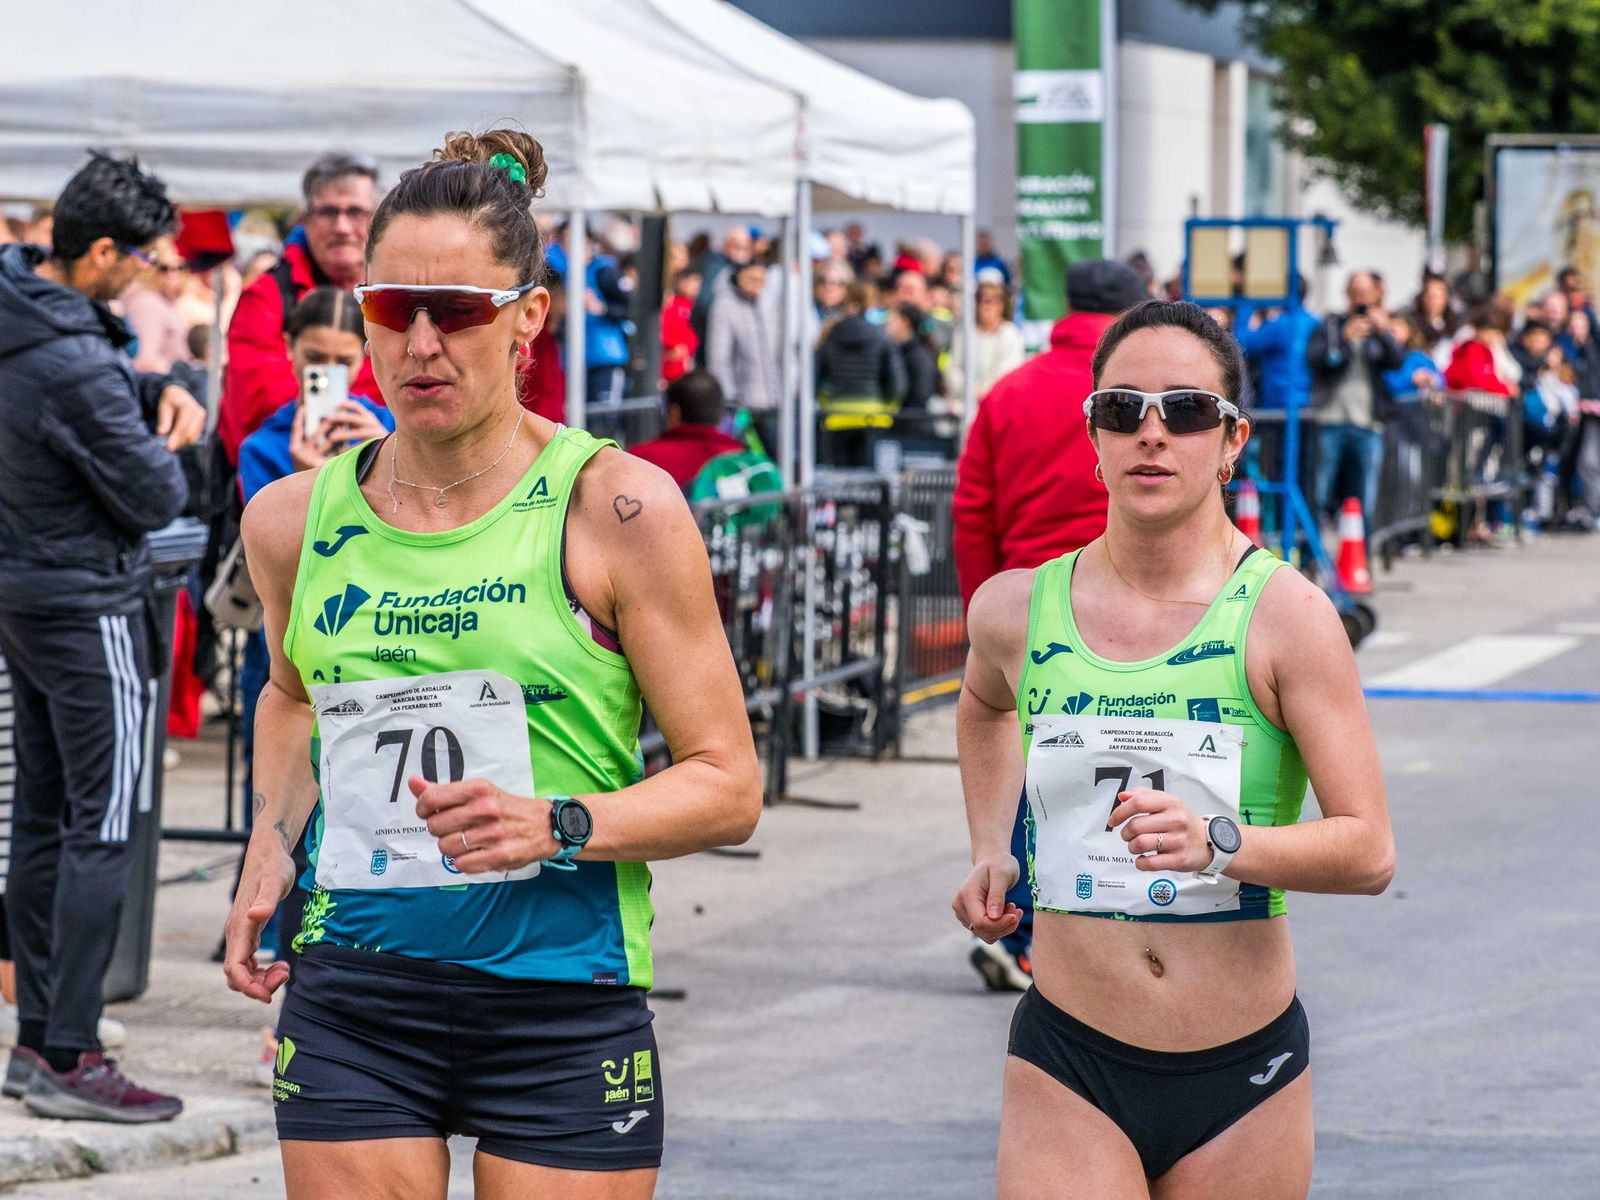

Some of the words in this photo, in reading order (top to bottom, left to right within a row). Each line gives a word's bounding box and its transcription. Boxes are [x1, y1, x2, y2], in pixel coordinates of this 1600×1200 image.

[376, 576, 526, 609] Fundación
[373, 606, 478, 640] Unicaja
[371, 644, 417, 663] Jaén
[392, 695, 415, 704] MARCHA
[1098, 691, 1177, 707] Fundación
[374, 726, 465, 803] 70
[374, 828, 401, 836] AINHOA
[1087, 855, 1110, 863] MARIA
[1112, 856, 1134, 864] MOYA
